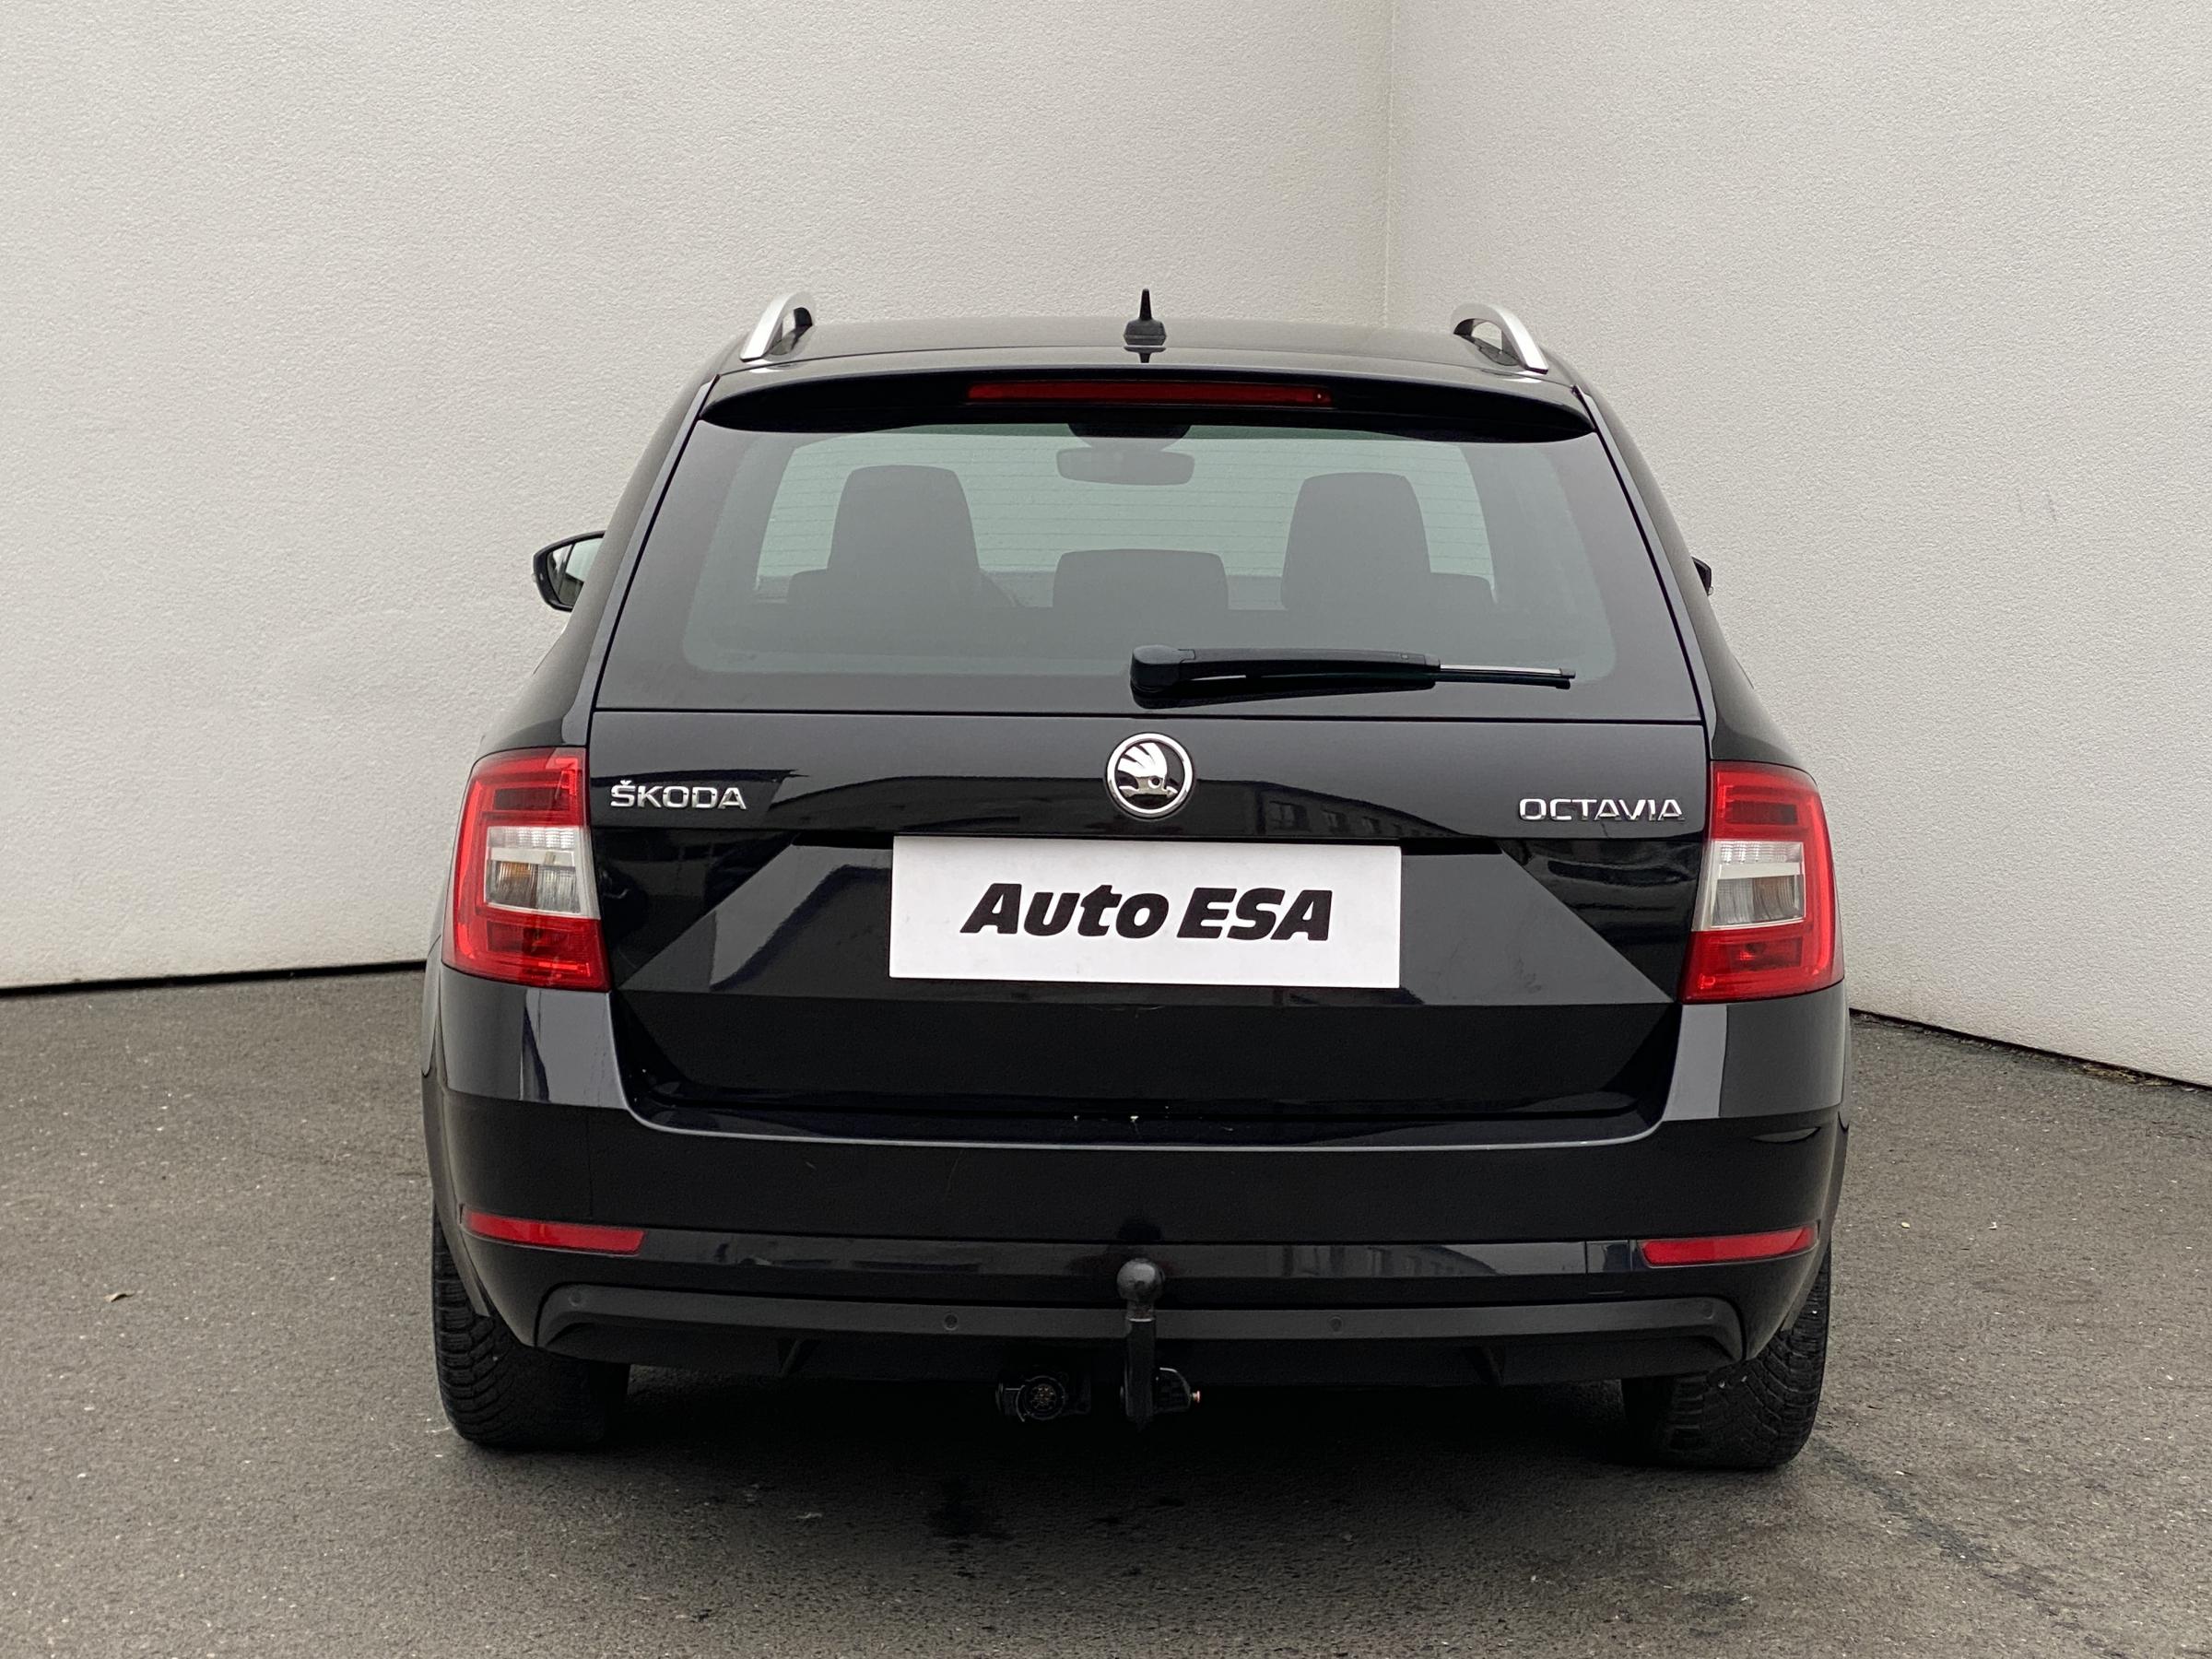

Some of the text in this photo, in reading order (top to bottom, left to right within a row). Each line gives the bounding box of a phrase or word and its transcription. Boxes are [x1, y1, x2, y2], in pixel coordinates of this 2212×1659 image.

[610, 780, 747, 810] ŠKODA
[1519, 798, 1686, 821] OCTAVIA
[959, 883, 1333, 941] Auto ESA
